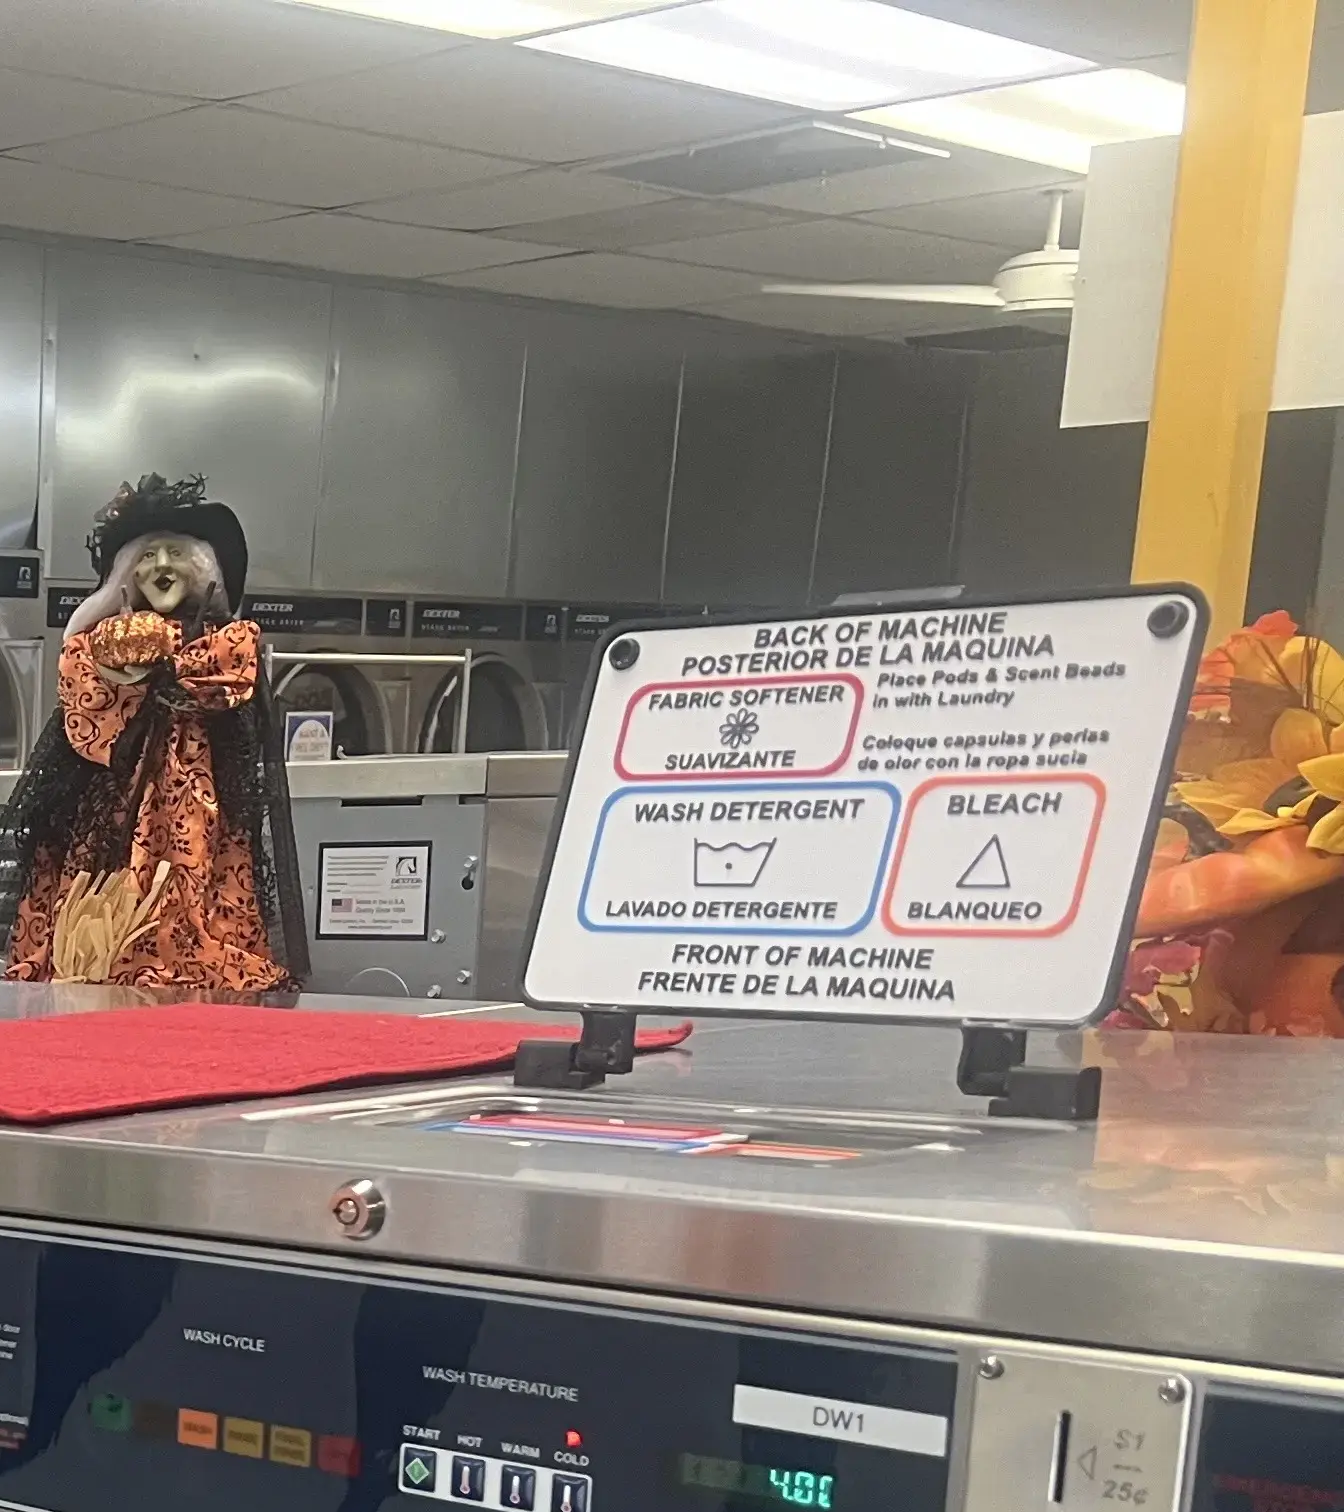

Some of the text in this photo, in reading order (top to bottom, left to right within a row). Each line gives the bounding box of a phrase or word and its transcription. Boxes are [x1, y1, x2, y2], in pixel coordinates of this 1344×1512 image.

[755, 612, 1008, 649] BACK OF MACHINE
[682, 634, 1054, 676] POSTERIOR DE LA MAQUINA
[877, 661, 1126, 687] Place Pods & Scent Beads
[649, 685, 845, 711] FABRIC SOFTENER
[872, 689, 1016, 709] in with Laundry
[863, 728, 1110, 753] Coloque capsulas y perlas
[665, 750, 796, 771] SUAVIZANTE
[858, 751, 1088, 771] de olor con la ropa sucia
[635, 798, 865, 823] WASH DETERGENT
[947, 792, 1063, 816] BLEACH
[606, 900, 838, 919] LAVADO DETERGENTE
[908, 901, 1042, 920] BLANQUEO
[672, 944, 934, 970] FRONT OF MACHINE
[638, 971, 955, 1001] FRENTE DE LA MAQUINA
[183, 1327, 265, 1353] WASH CYCLE
[422, 1366, 579, 1402] WASH TEMPERATURE
[812, 1406, 866, 1433] DW1
[403, 1424, 441, 1441] START
[457, 1435, 483, 1448] HOT
[501, 1442, 540, 1458] WARM
[554, 1451, 589, 1466] COLD
